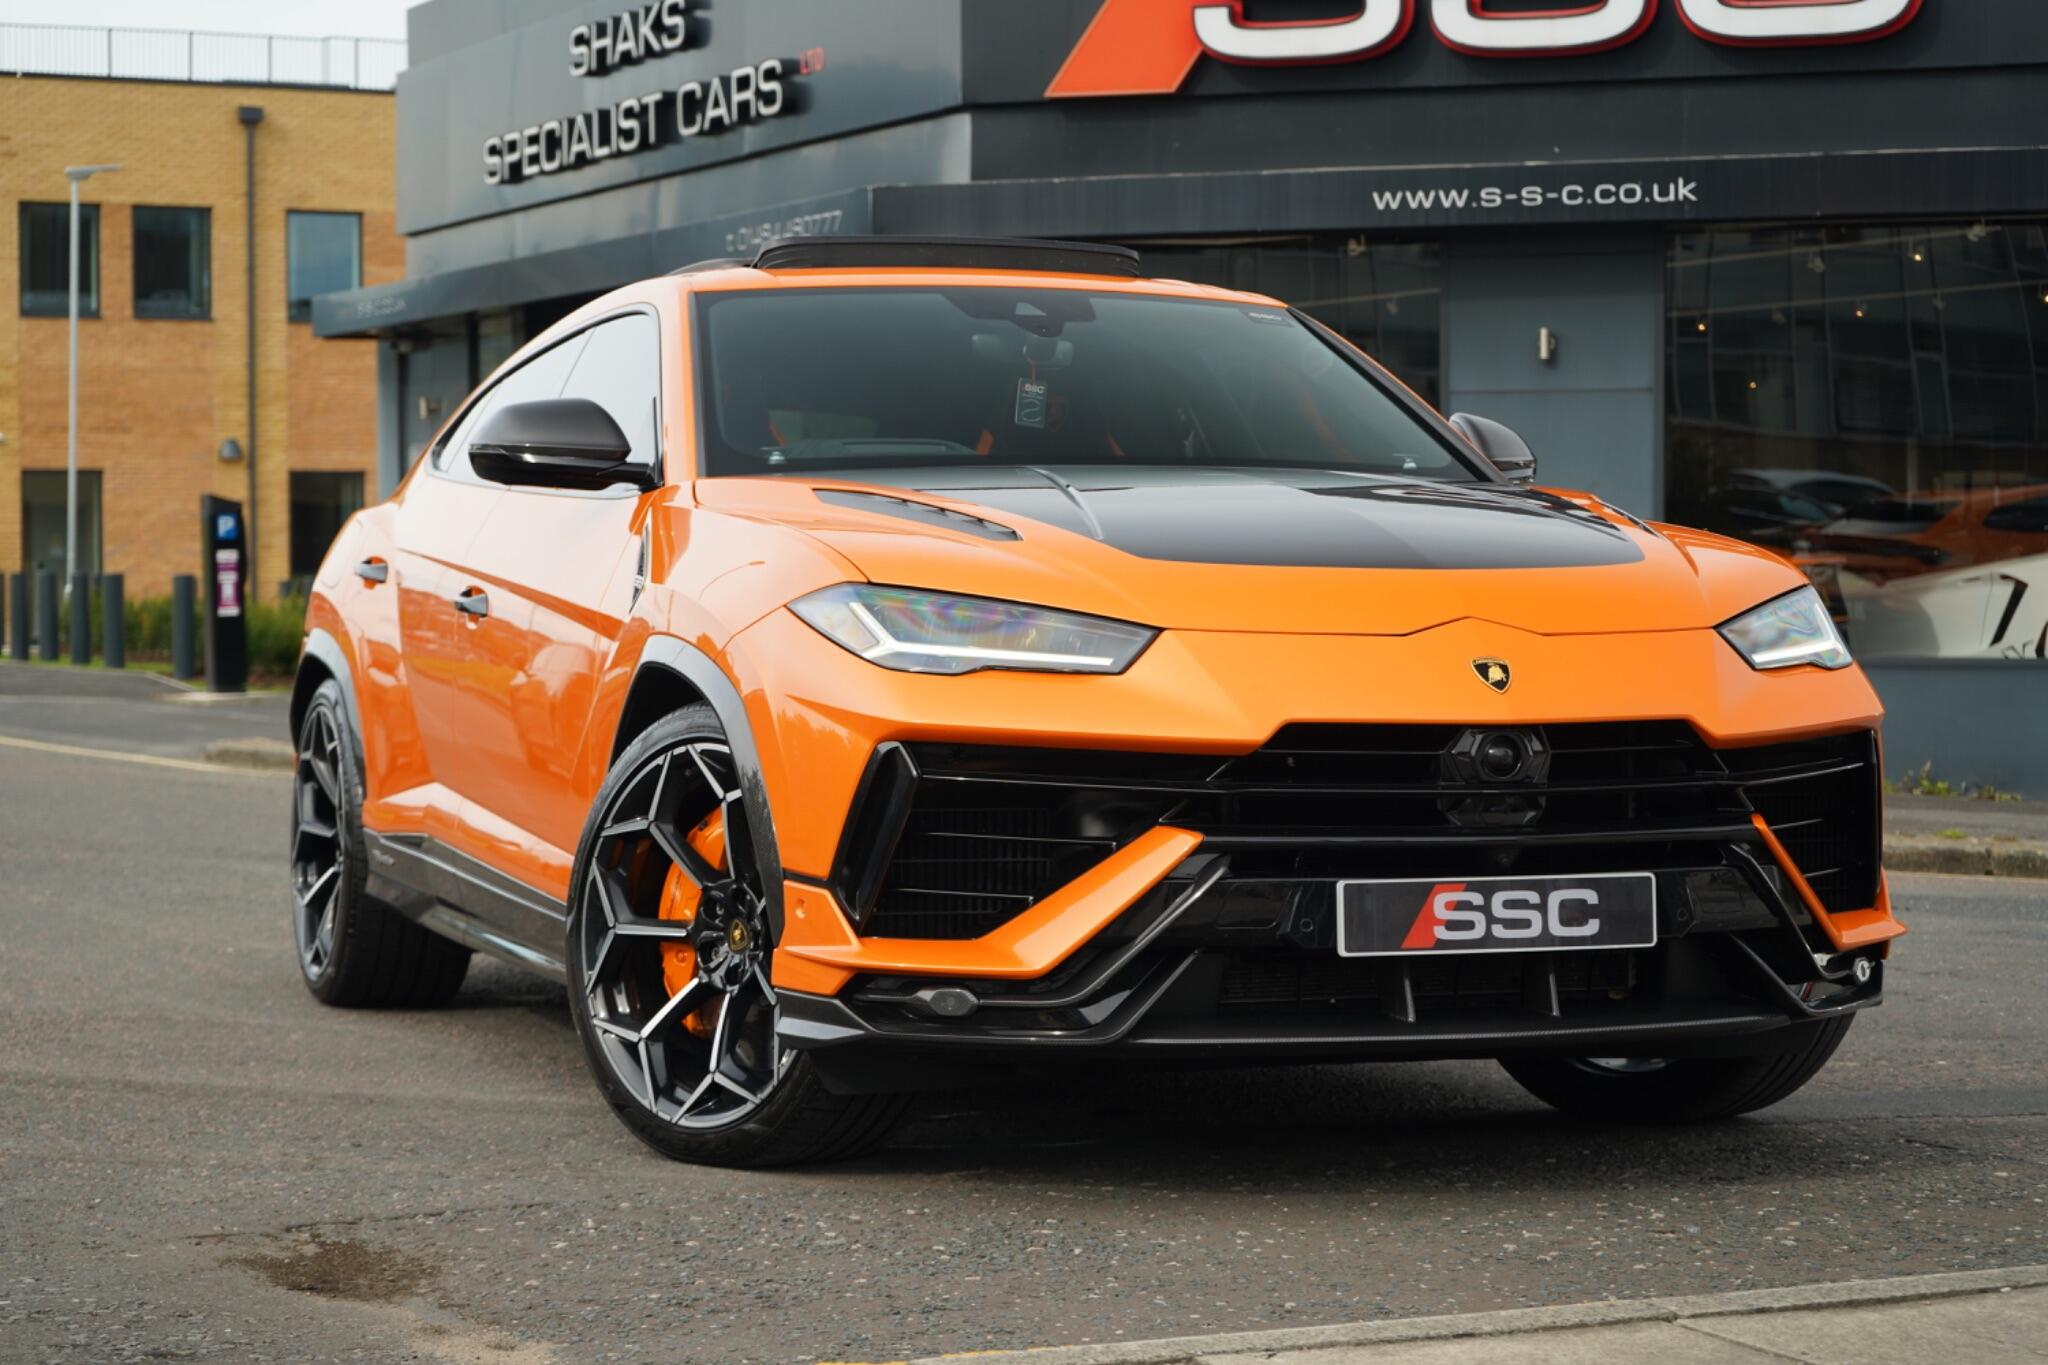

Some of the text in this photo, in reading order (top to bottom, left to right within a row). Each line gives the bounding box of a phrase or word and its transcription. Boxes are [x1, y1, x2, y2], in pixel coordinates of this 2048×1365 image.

[569, 0, 686, 77] SHAKS
[482, 92, 663, 184] SPECIALIST
[676, 59, 783, 137] CARS
[1372, 177, 1698, 210] www.s-s-c.co.uk
[1432, 888, 1600, 941] SSC
